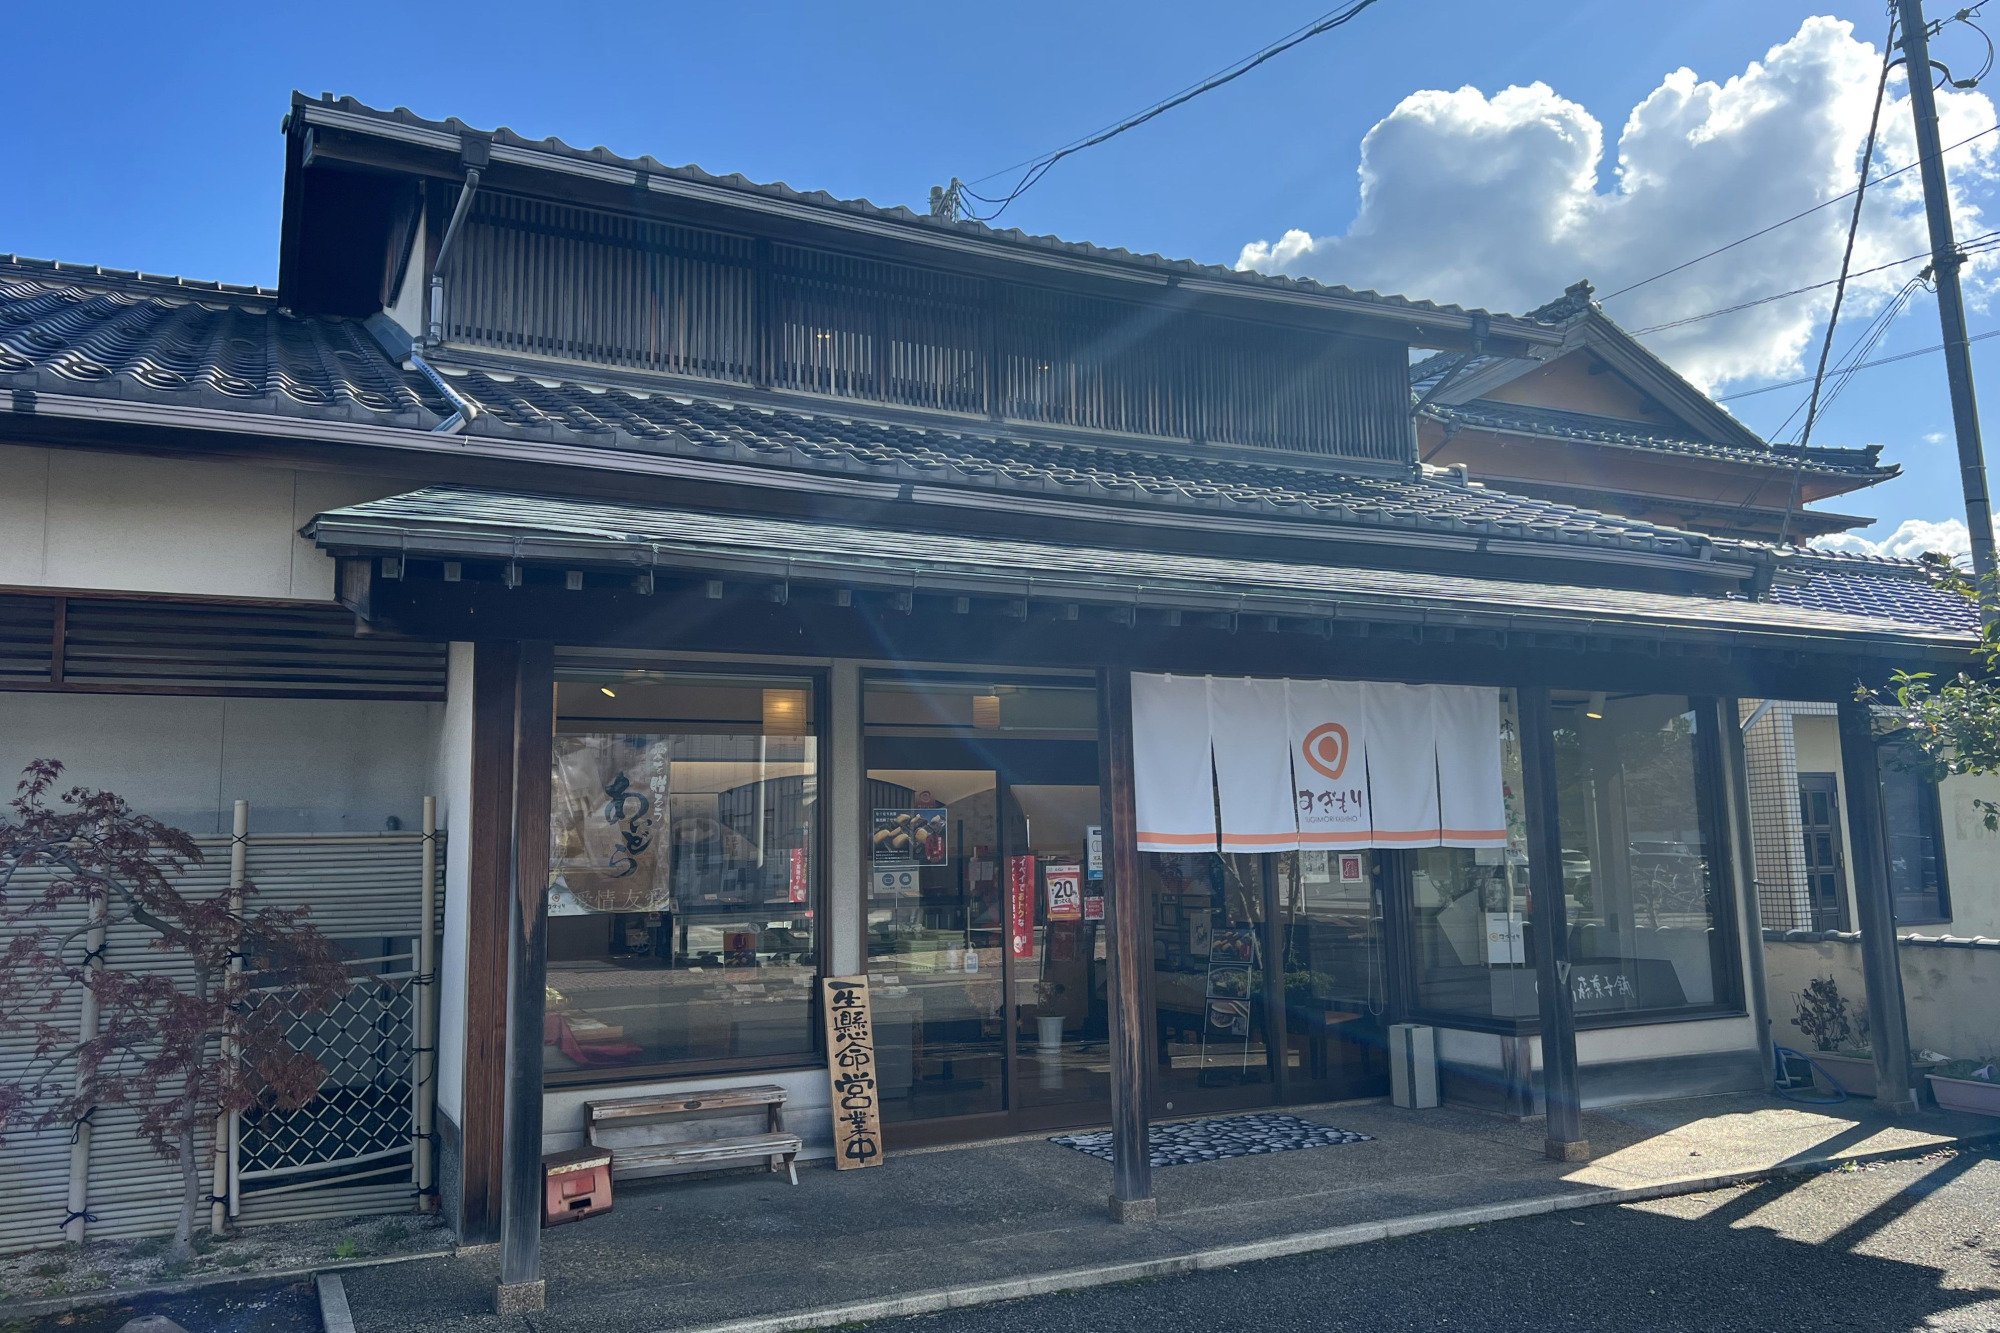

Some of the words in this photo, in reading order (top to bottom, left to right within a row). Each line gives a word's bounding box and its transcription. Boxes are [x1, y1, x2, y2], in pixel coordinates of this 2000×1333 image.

[1299, 789, 1362, 817] すぎもり
[1304, 815, 1334, 823] SUGIMORI
[1572, 974, 1635, 1003] 森菓子舗
